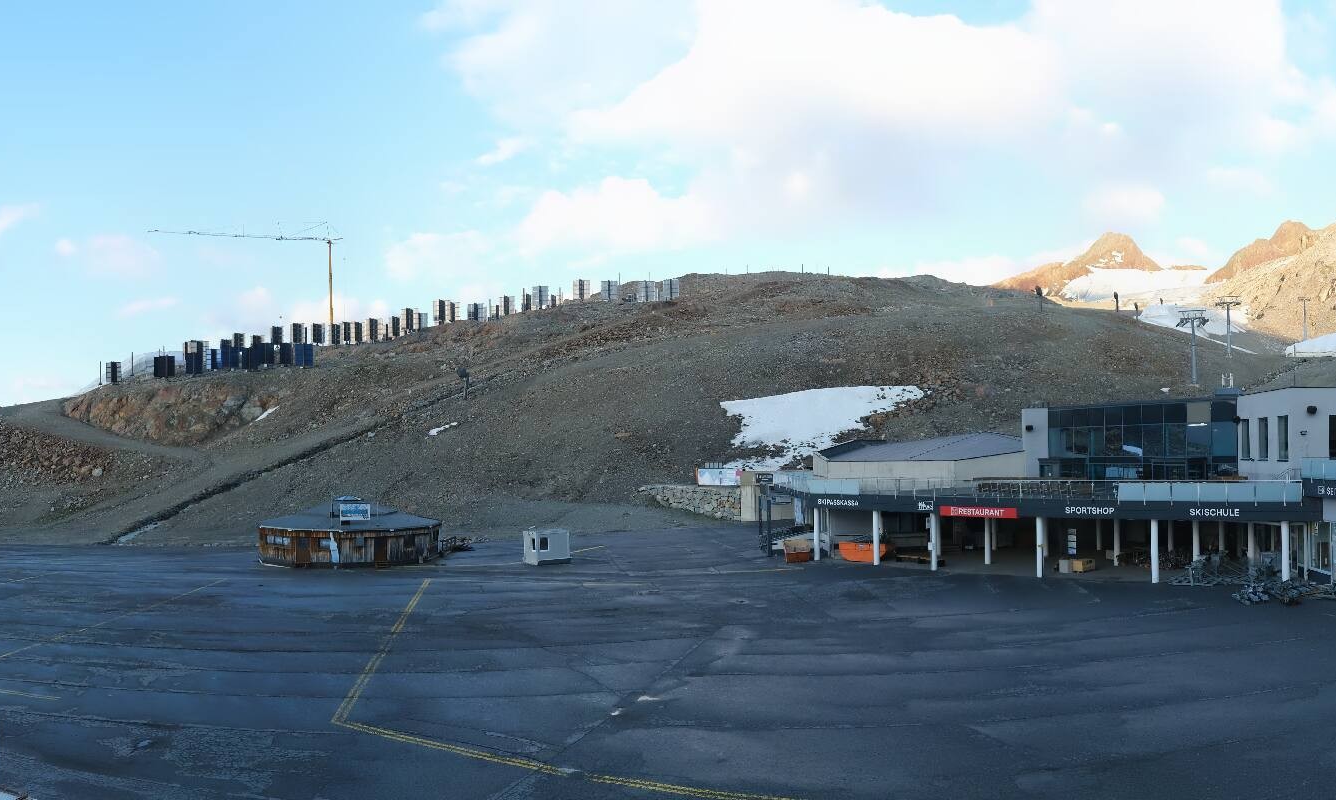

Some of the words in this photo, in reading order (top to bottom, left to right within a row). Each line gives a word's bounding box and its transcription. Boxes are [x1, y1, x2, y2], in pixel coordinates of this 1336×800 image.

[817, 498, 859, 506] SKIPASSKASSA
[958, 507, 1005, 517] RESTAURANT
[1065, 506, 1115, 515] SPORTSHOP
[1189, 508, 1240, 517] SKISCHULE
